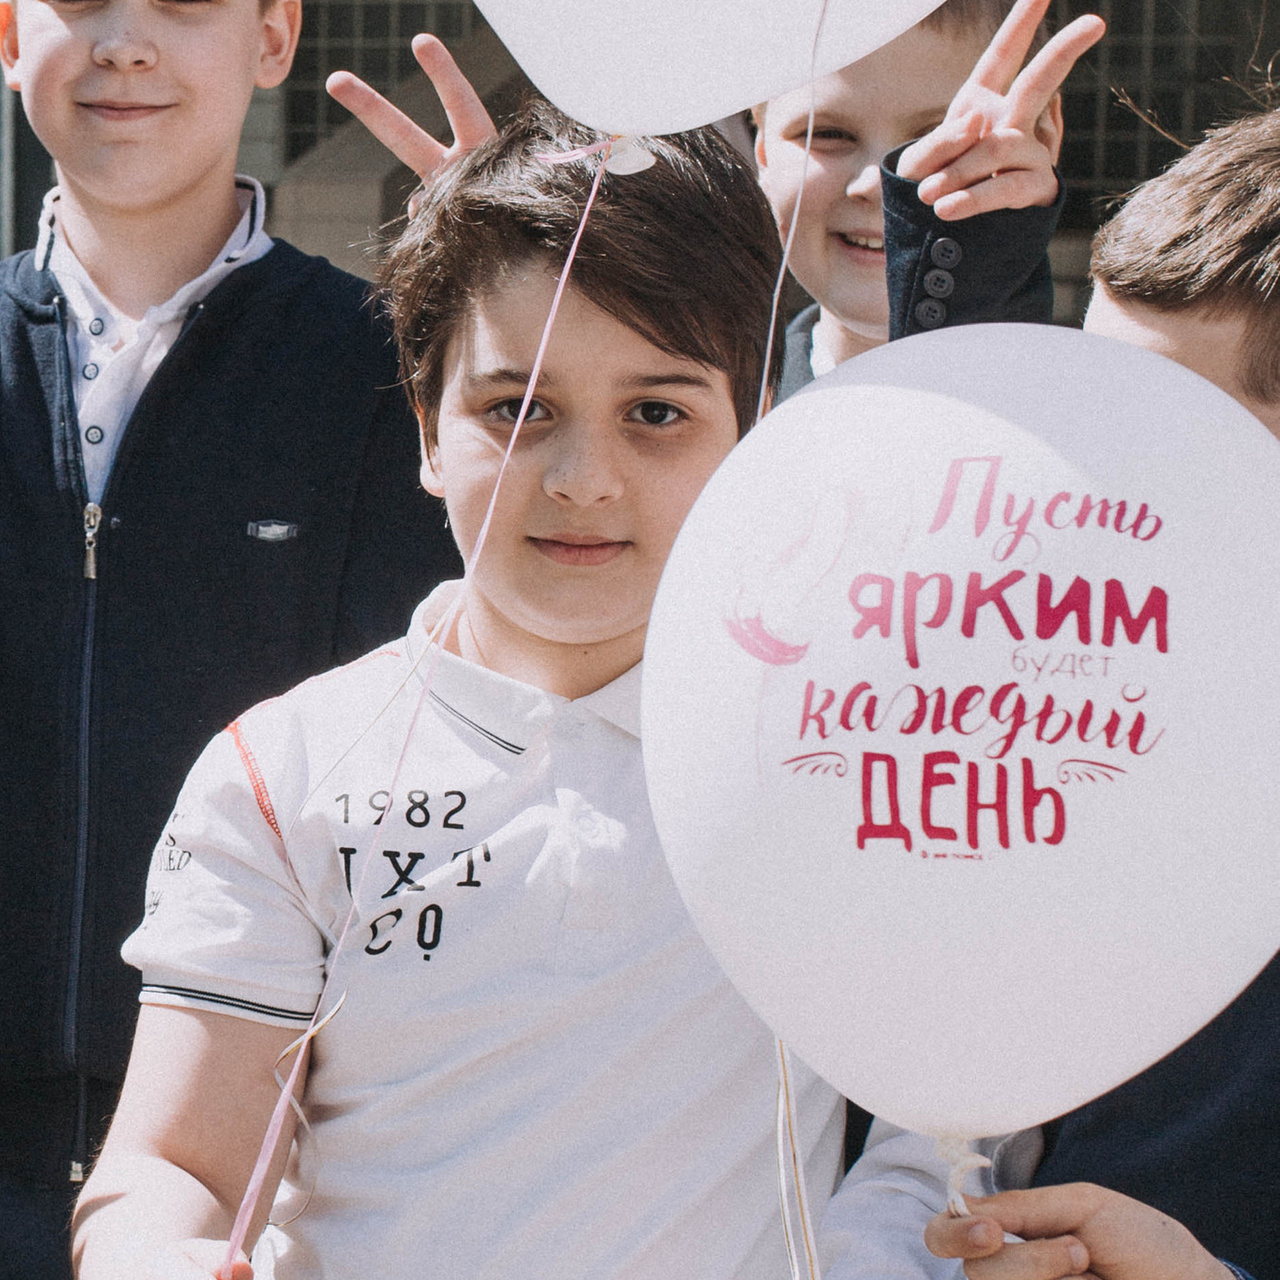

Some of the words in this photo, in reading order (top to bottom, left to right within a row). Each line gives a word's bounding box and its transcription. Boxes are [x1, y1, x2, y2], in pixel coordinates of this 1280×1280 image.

[927, 456, 1162, 561] Пусть
[798, 679, 1166, 759] каждый
[335, 790, 467, 830] 1982
[856, 750, 1067, 852] ДЕНЬ
